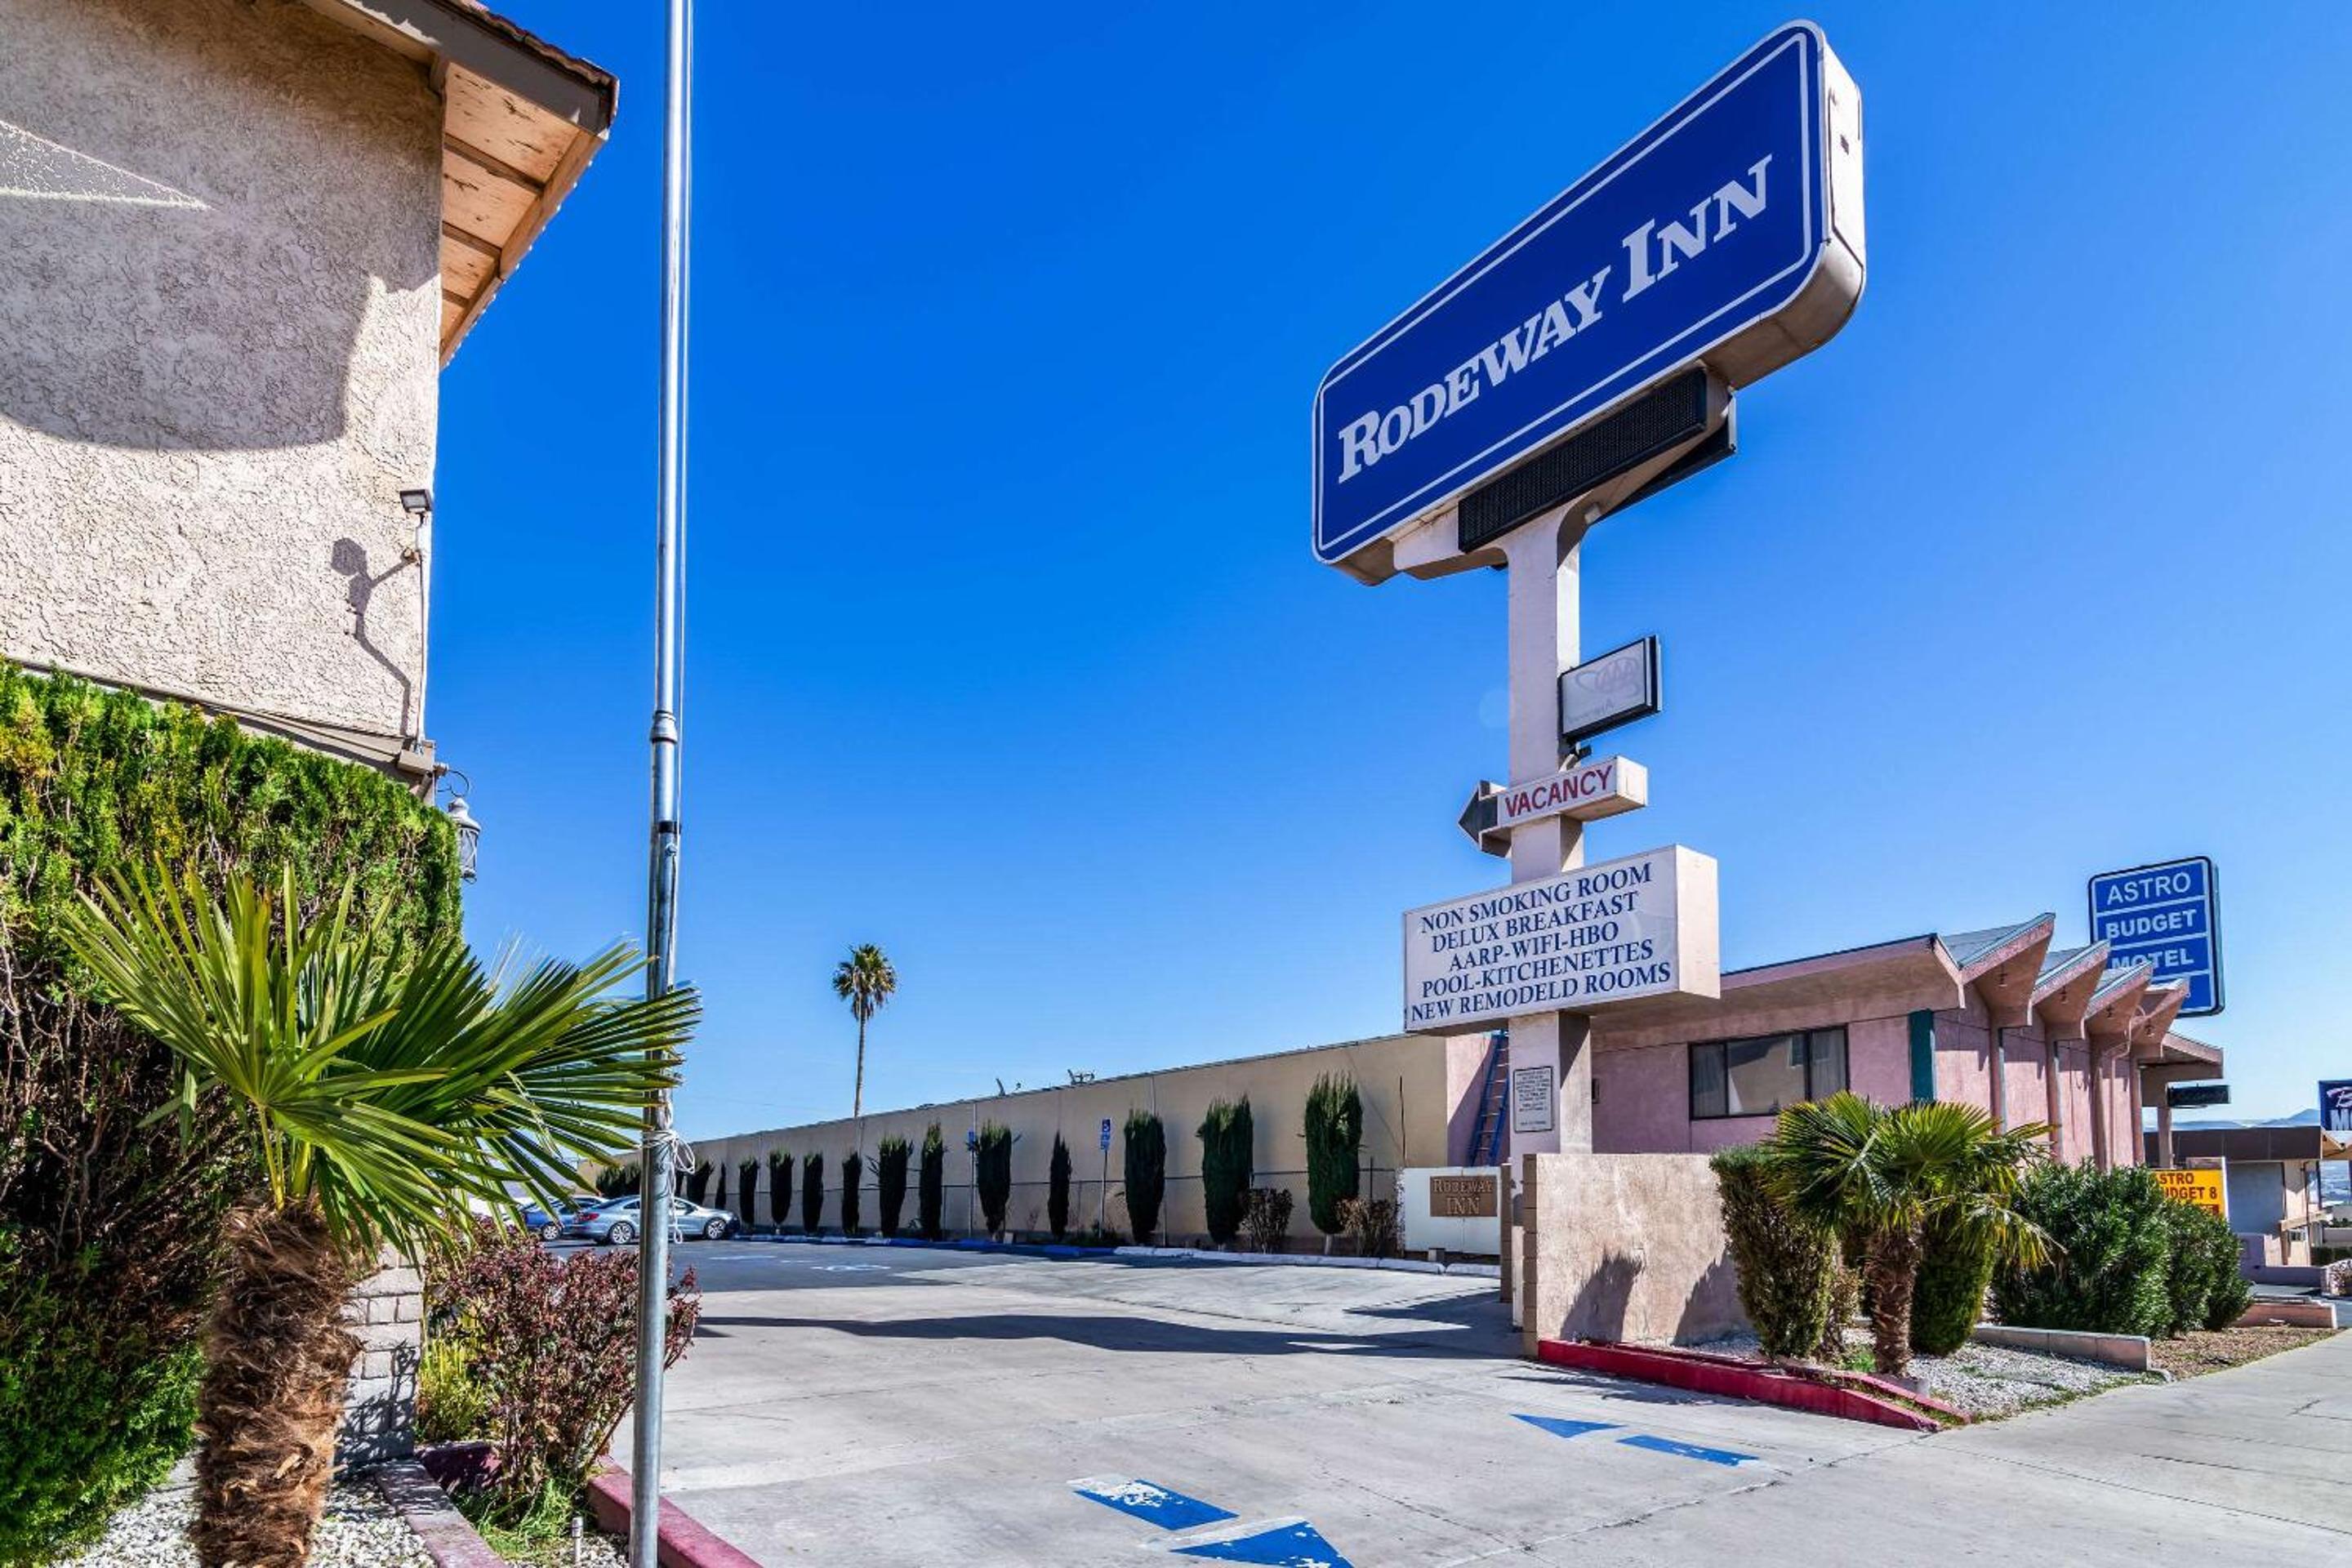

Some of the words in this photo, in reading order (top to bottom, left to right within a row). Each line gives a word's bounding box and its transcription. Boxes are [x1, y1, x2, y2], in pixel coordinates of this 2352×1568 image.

[1338, 265, 1610, 484] RODEWAY
[1622, 153, 1772, 303] INN
[1504, 765, 1613, 817] VACANCY
[1421, 907, 1463, 933] NON
[1469, 882, 1571, 923] SMOKING
[1577, 862, 1651, 898] ROOM
[2107, 871, 2191, 905] ASTRO
[1432, 922, 1500, 953] DELUX
[1506, 891, 1639, 937] BREAKFAST
[1450, 921, 1619, 972] AARP-WIFI-HBO
[2105, 909, 2198, 938] BUDGET
[1423, 938, 1654, 998] POOL-KITCHENETTES
[2111, 948, 2194, 969] MOTEL
[1411, 999, 1454, 1022] NEW
[1460, 978, 1578, 1014] REMODELD
[1584, 962, 1671, 995] ROOMS
[2156, 1173, 2194, 1184] STRO
[2165, 1187, 2205, 1199] DGET
[2209, 1187, 2217, 1200] 8
[1446, 1197, 1480, 1214] INN
